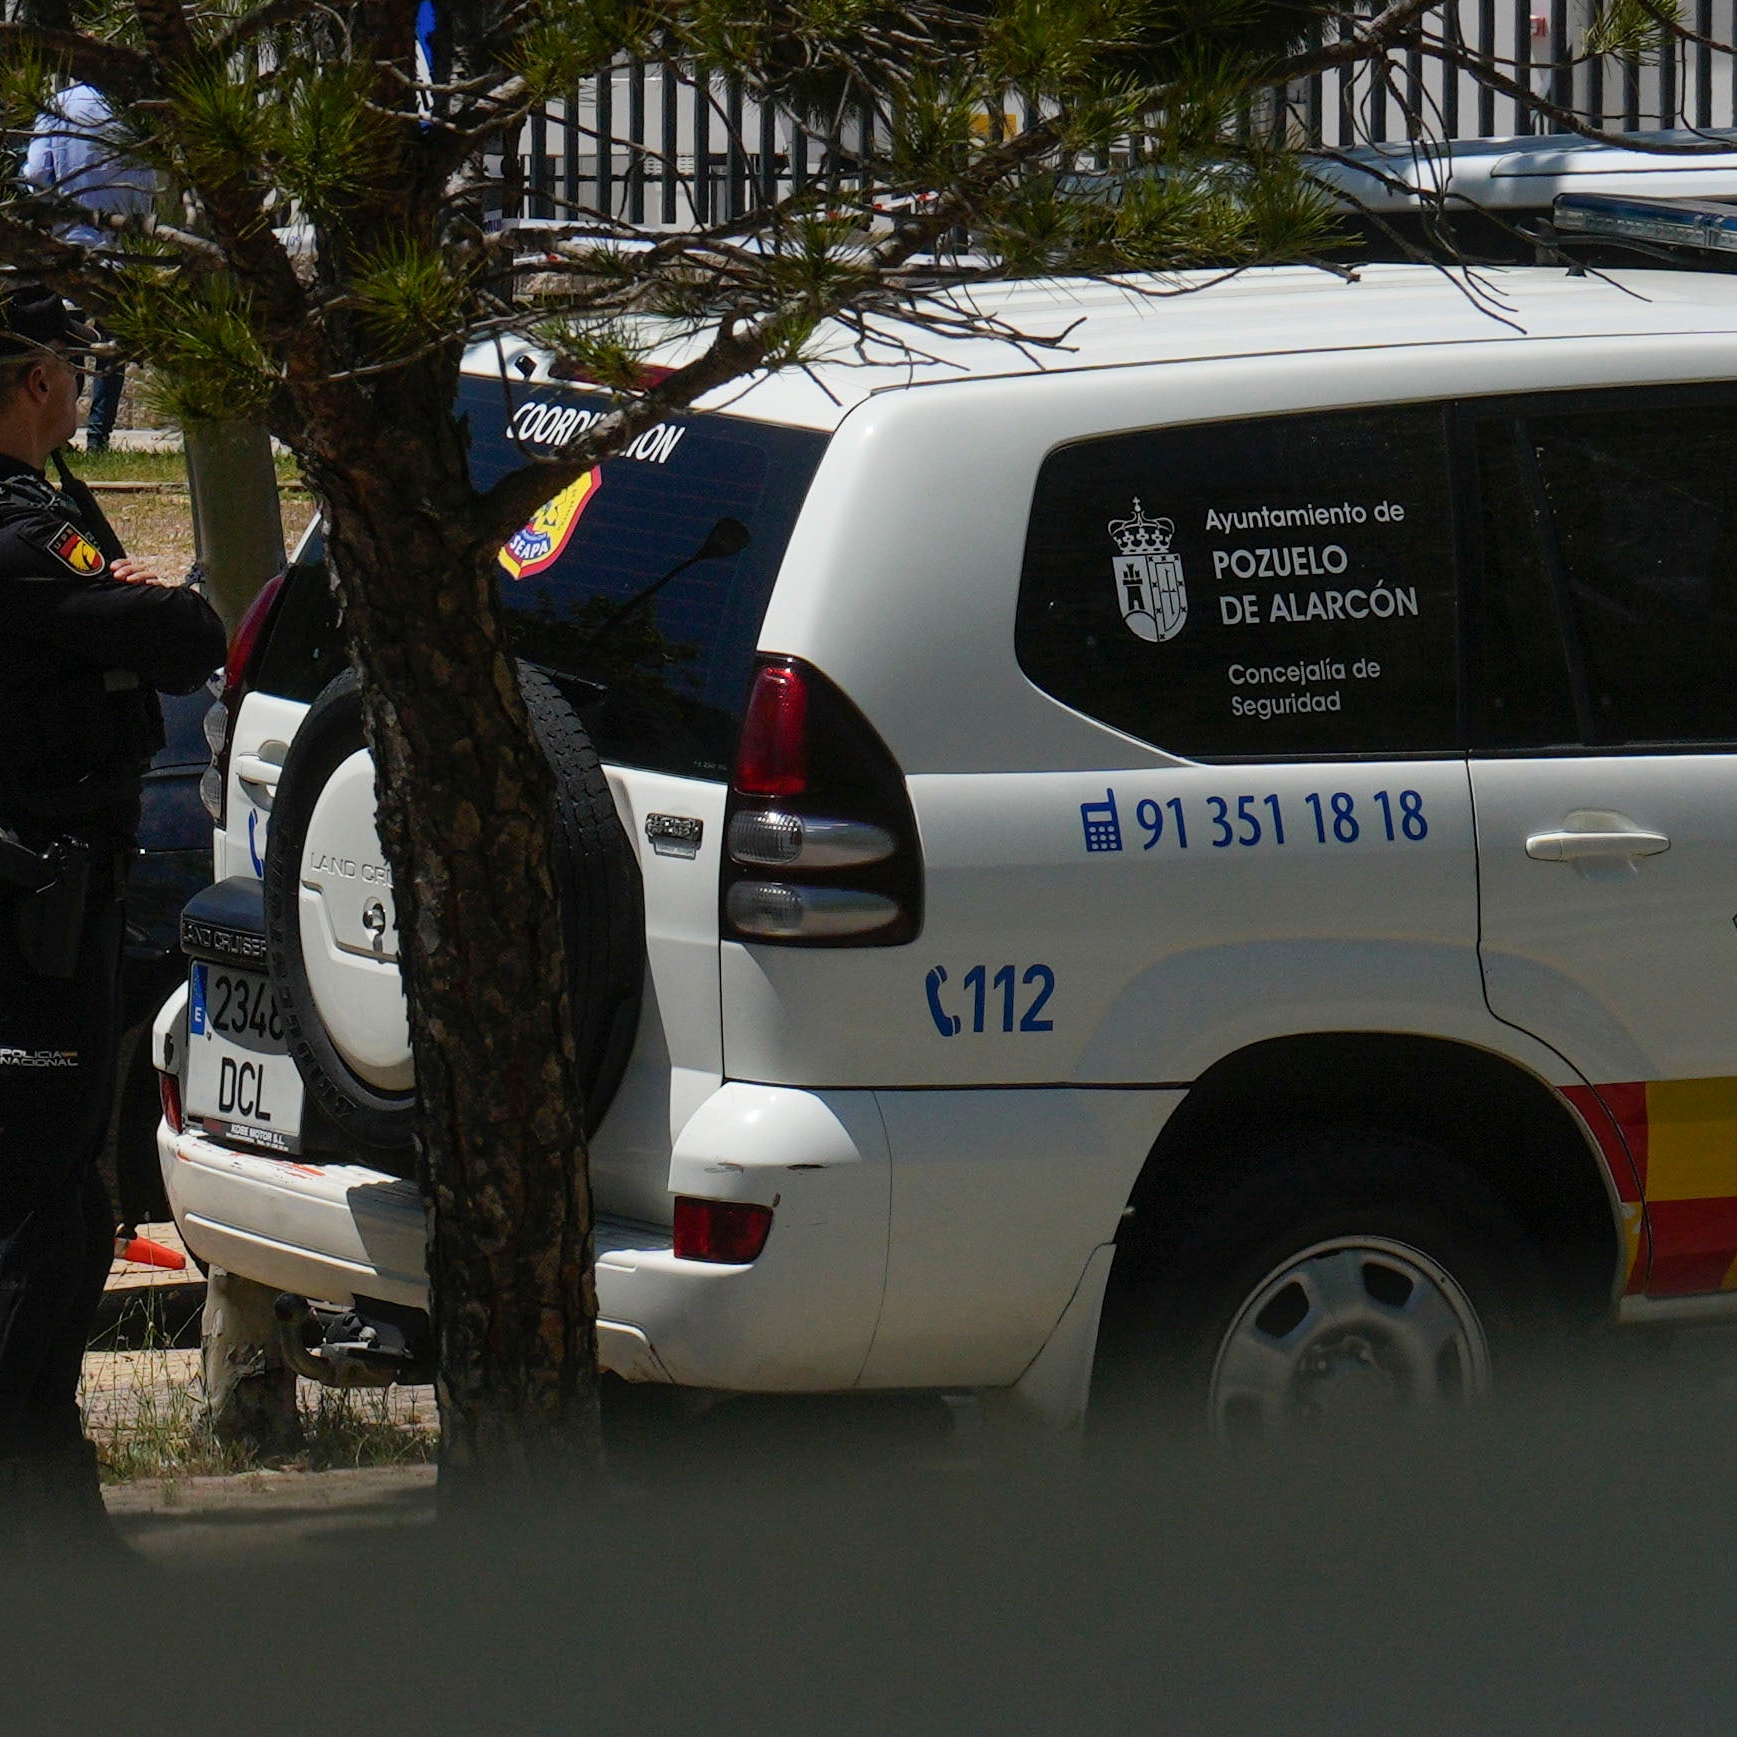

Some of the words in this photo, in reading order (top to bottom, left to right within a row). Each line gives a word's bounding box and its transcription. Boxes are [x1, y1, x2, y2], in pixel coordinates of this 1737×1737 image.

[1206, 502, 1367, 534] Ayuntamiento
[1373, 500, 1405, 523] de
[509, 534, 549, 559] SEAPA
[1212, 545, 1348, 579] POZUELO
[1220, 594, 1261, 625] DE
[1269, 579, 1419, 622] ALARCÓN
[1229, 658, 1346, 686] Concejalía
[1353, 658, 1381, 679] de
[1231, 691, 1341, 720] Seguridad
[1136, 797, 1188, 852] 91
[1205, 793, 1285, 848] 351
[1304, 792, 1360, 844] 18
[1373, 789, 1429, 842] 18
[311, 852, 356, 880] LAND
[963, 964, 1055, 1033] 112
[194, 1007, 203, 1023] E
[0, 1056, 78, 1067] NACIONAL
[218, 1056, 271, 1122] DCL
